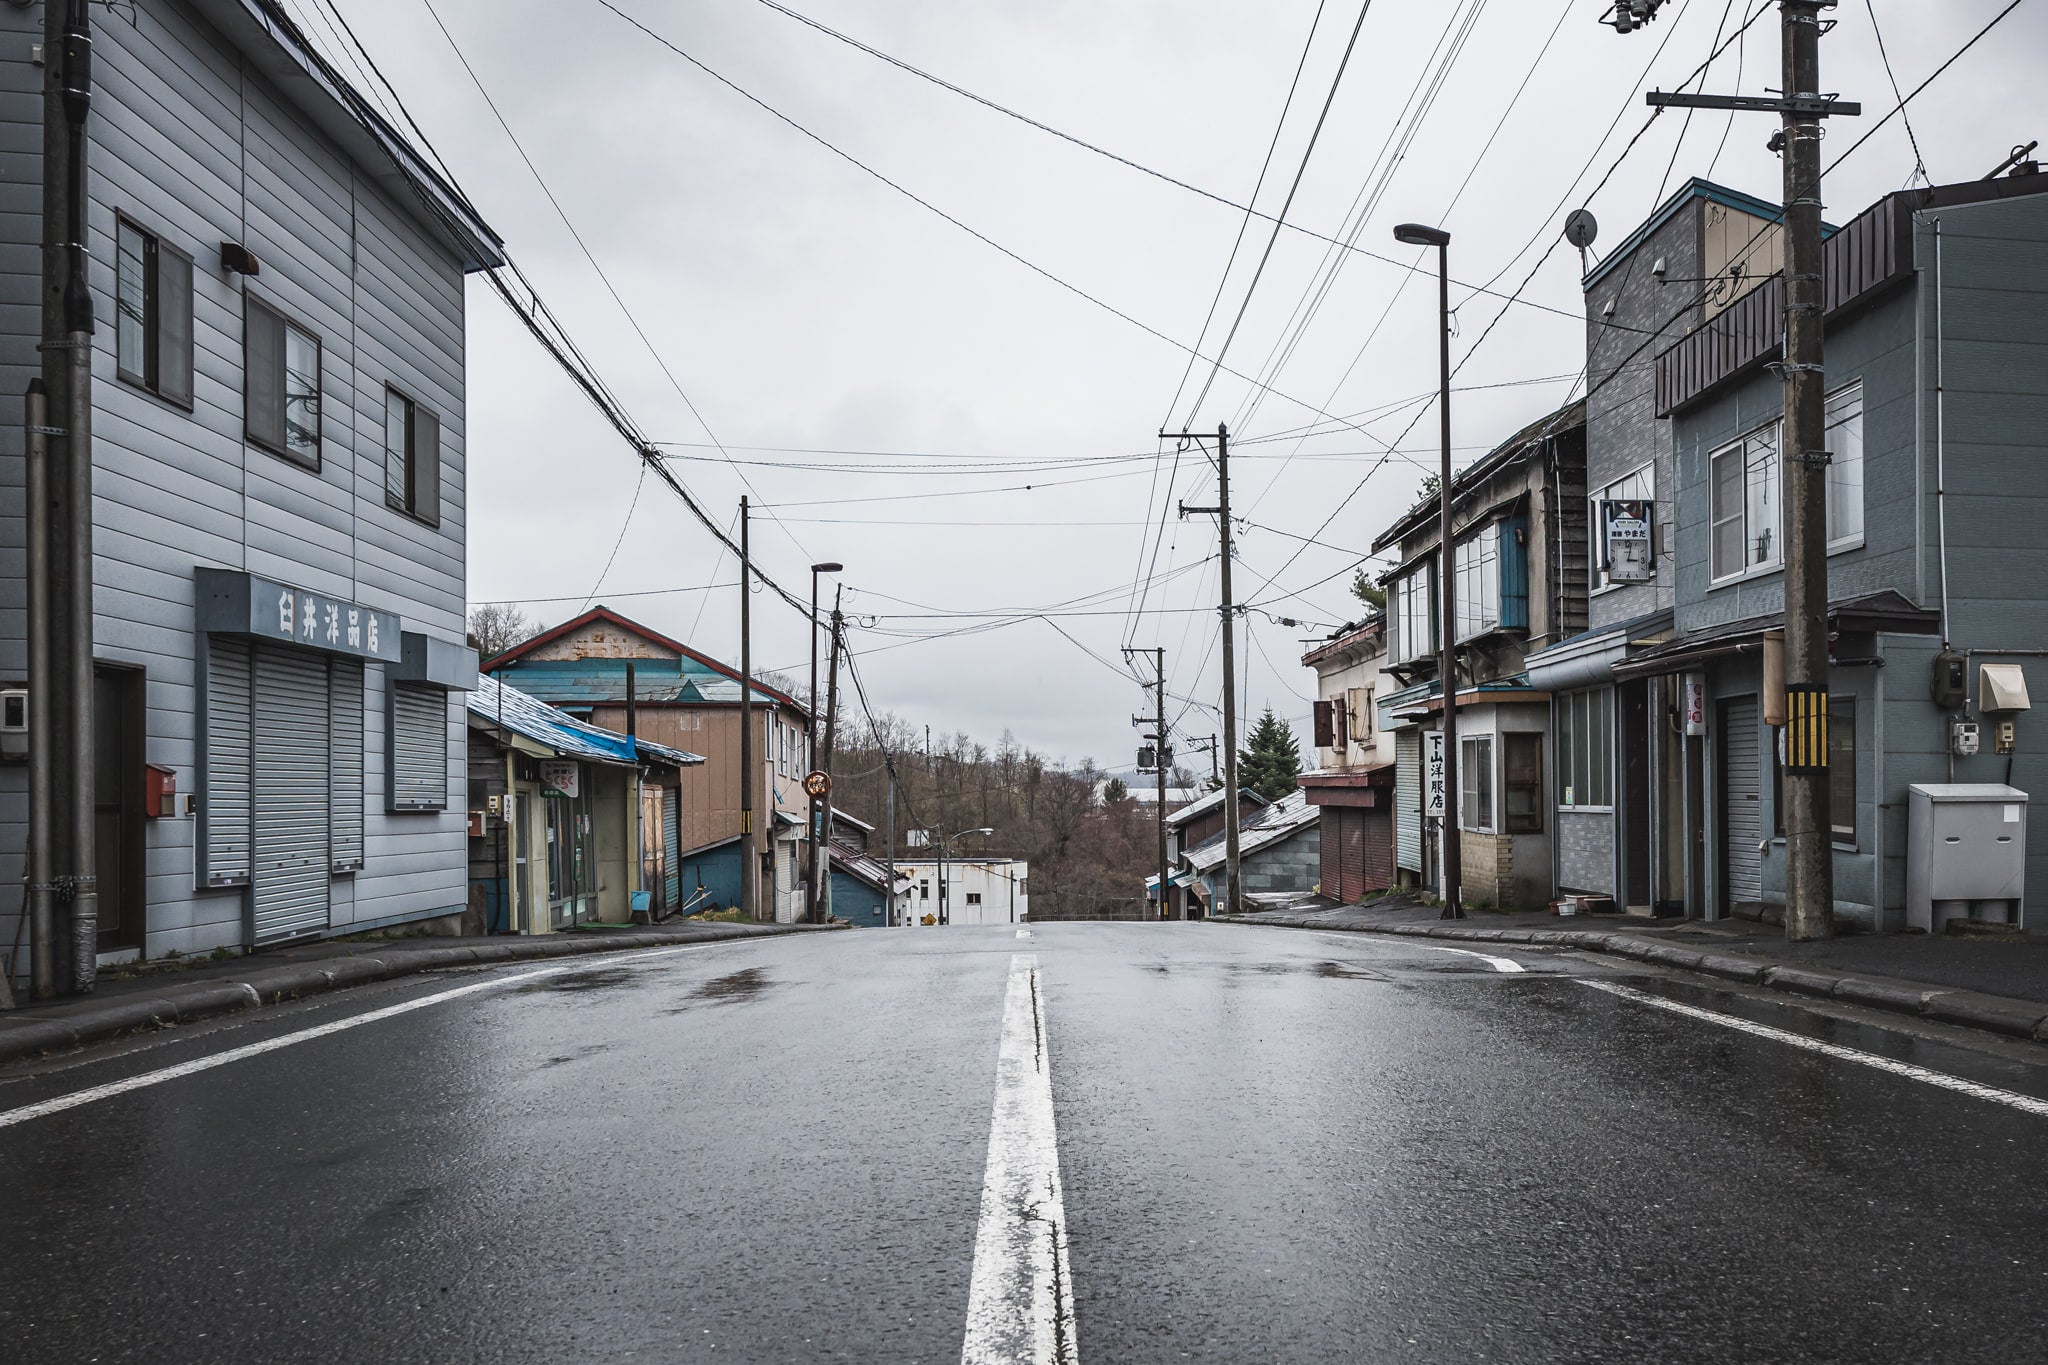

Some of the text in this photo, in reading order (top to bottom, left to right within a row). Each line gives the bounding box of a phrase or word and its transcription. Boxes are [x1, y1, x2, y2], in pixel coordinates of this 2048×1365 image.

[1624, 529, 1646, 538] やまだ
[279, 591, 378, 653] 臼井洋品店
[1429, 735, 1445, 809] 下山洋服店
